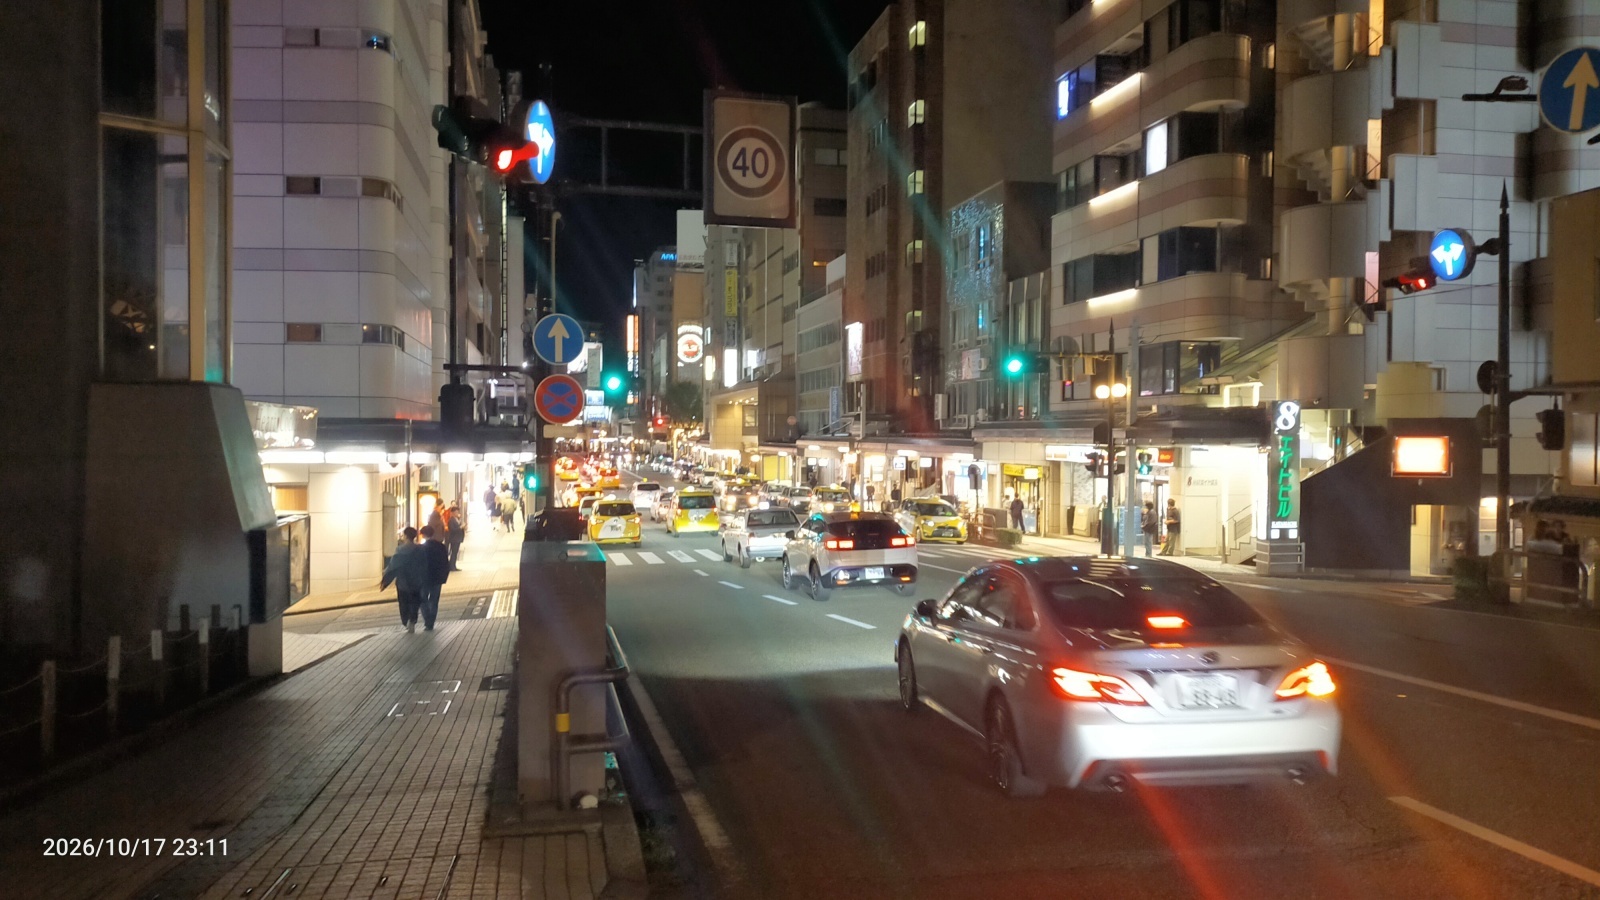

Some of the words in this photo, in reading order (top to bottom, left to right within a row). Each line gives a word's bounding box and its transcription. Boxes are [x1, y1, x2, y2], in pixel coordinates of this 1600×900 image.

[733, 147, 769, 178] 40
[1276, 401, 1300, 431] 8
[1276, 436, 1294, 519] エイトビル
